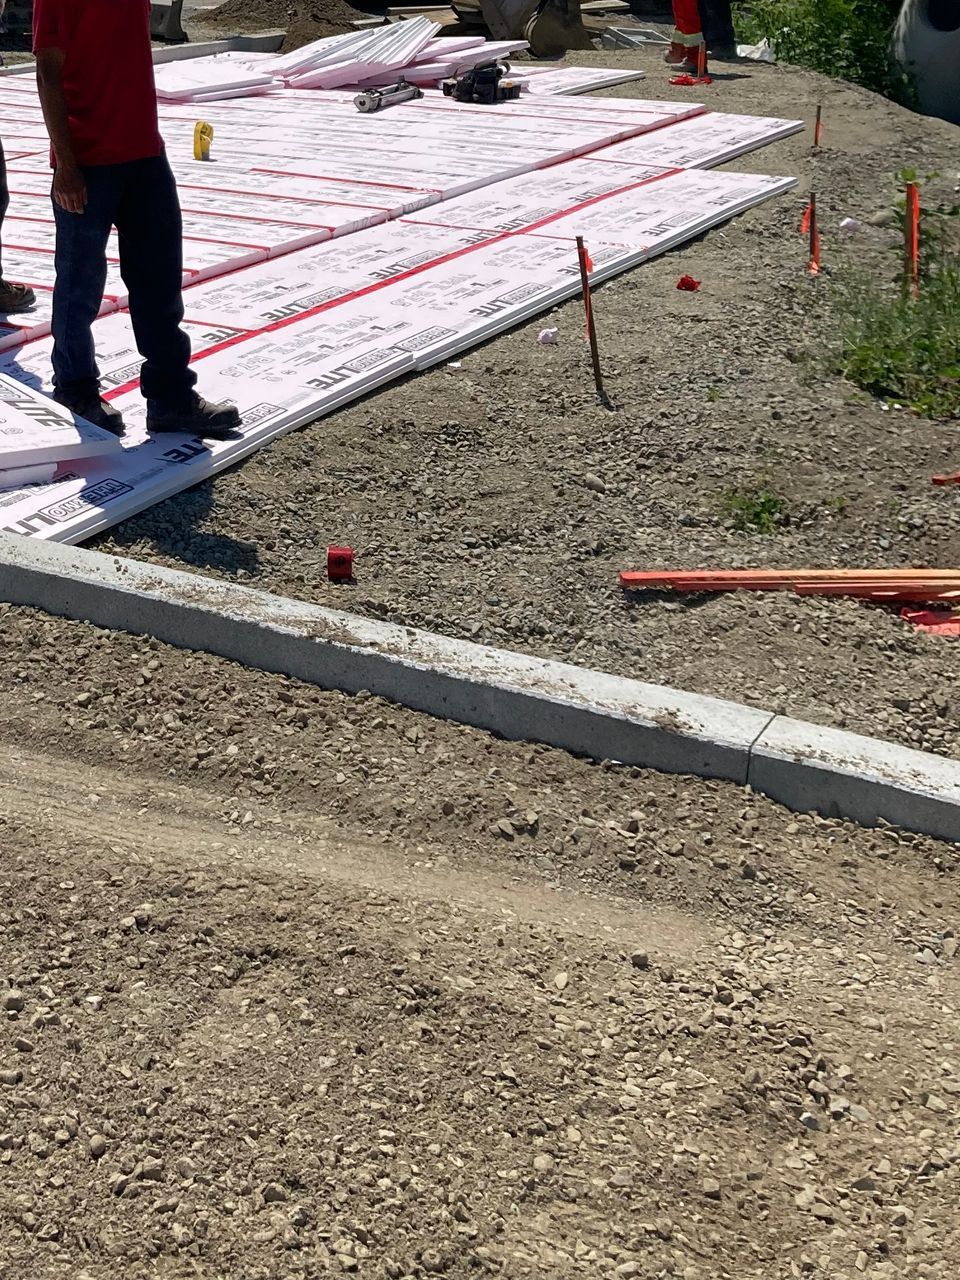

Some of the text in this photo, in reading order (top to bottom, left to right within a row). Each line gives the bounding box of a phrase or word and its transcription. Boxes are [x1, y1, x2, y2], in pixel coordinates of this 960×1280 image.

[368, 263, 411, 280] LITE
[261, 303, 304, 321] LITE
[468, 298, 515, 318] LITE
[306, 366, 360, 390] LITE
[1, 400, 76, 427] LITE
[47, 481, 126, 519] THERMO
